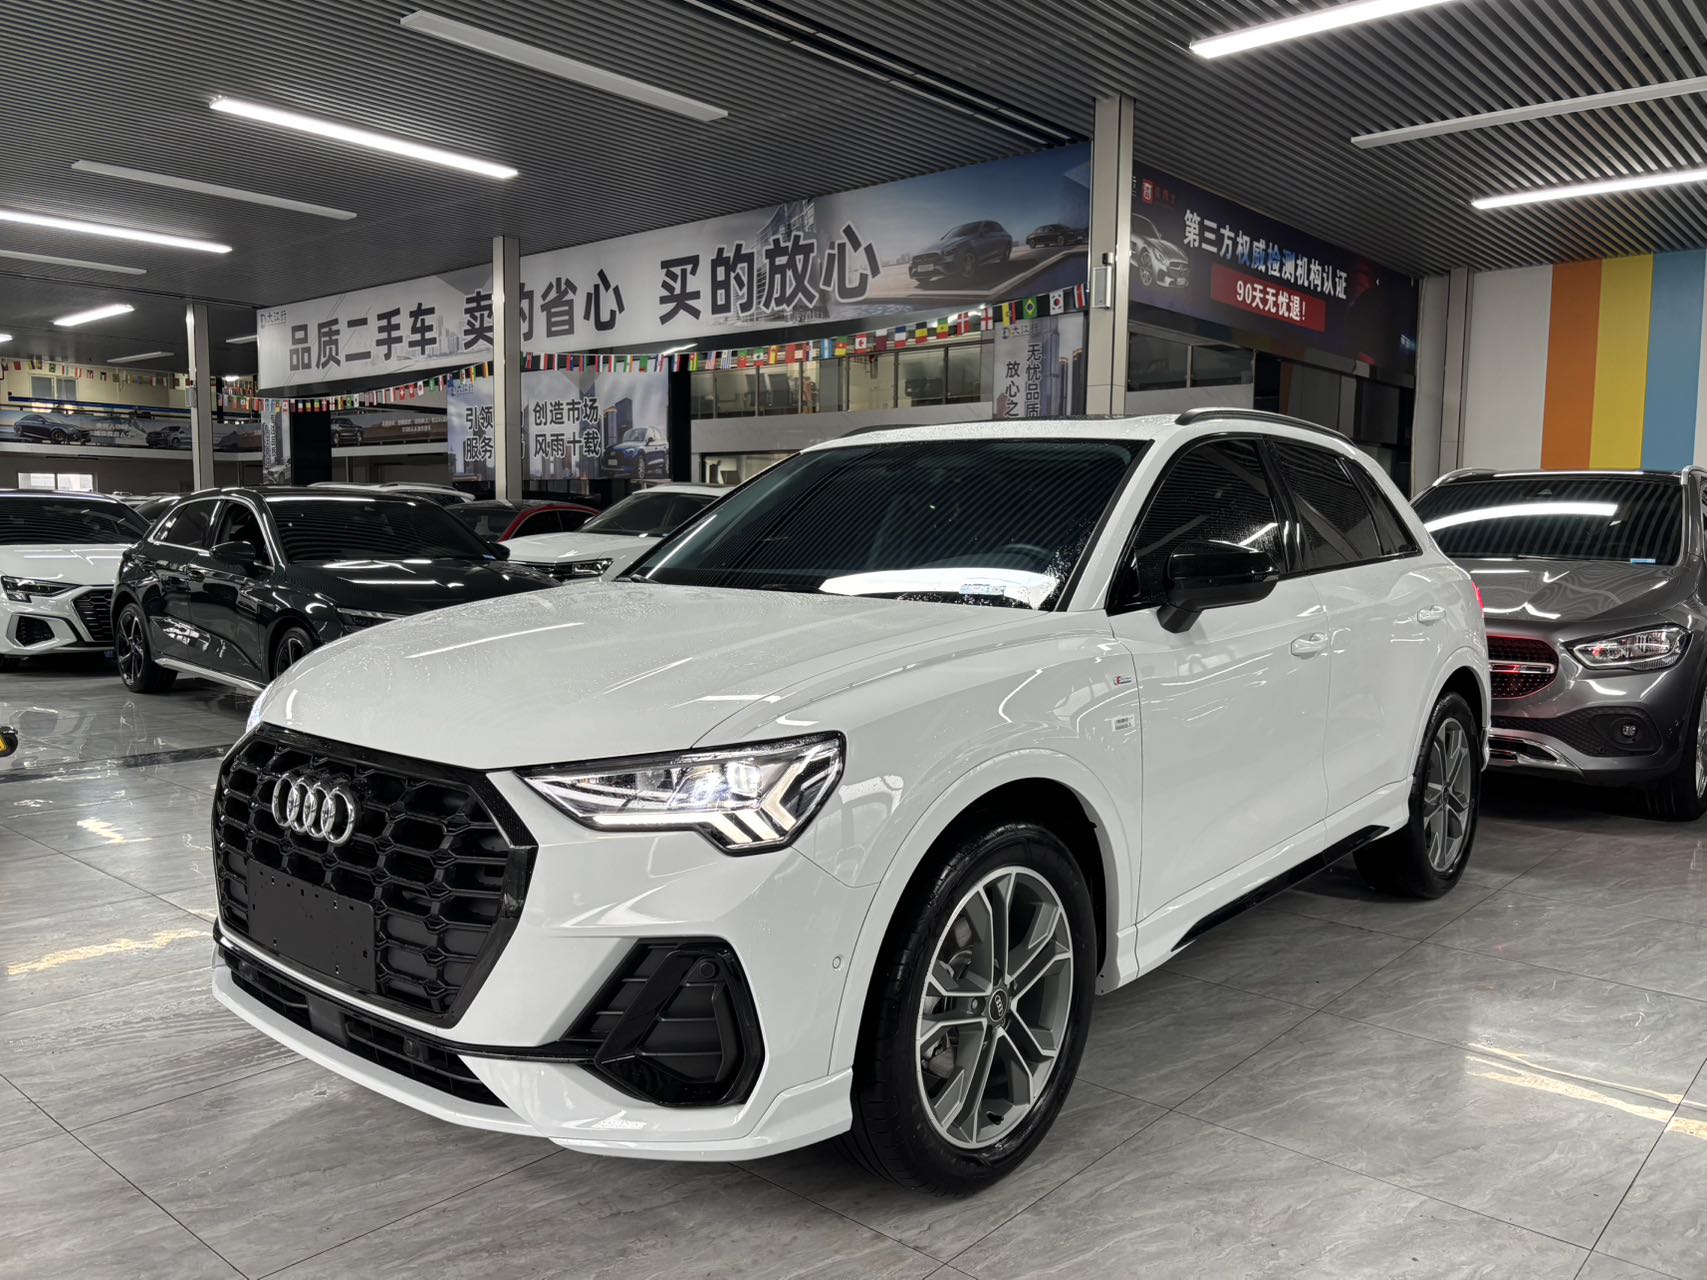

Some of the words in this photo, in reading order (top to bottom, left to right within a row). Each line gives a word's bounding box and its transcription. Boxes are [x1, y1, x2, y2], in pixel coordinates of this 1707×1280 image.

[1183, 209, 1349, 300] 第三方权威检测机构认证
[289, 302, 437, 372] 品质二手车
[658, 221, 881, 326] 买的放心
[532, 397, 600, 427] 创造市场
[1005, 360, 1021, 417] 放心之
[1025, 343, 1042, 417] 无忧品质
[532, 429, 601, 458] 风雨十载
